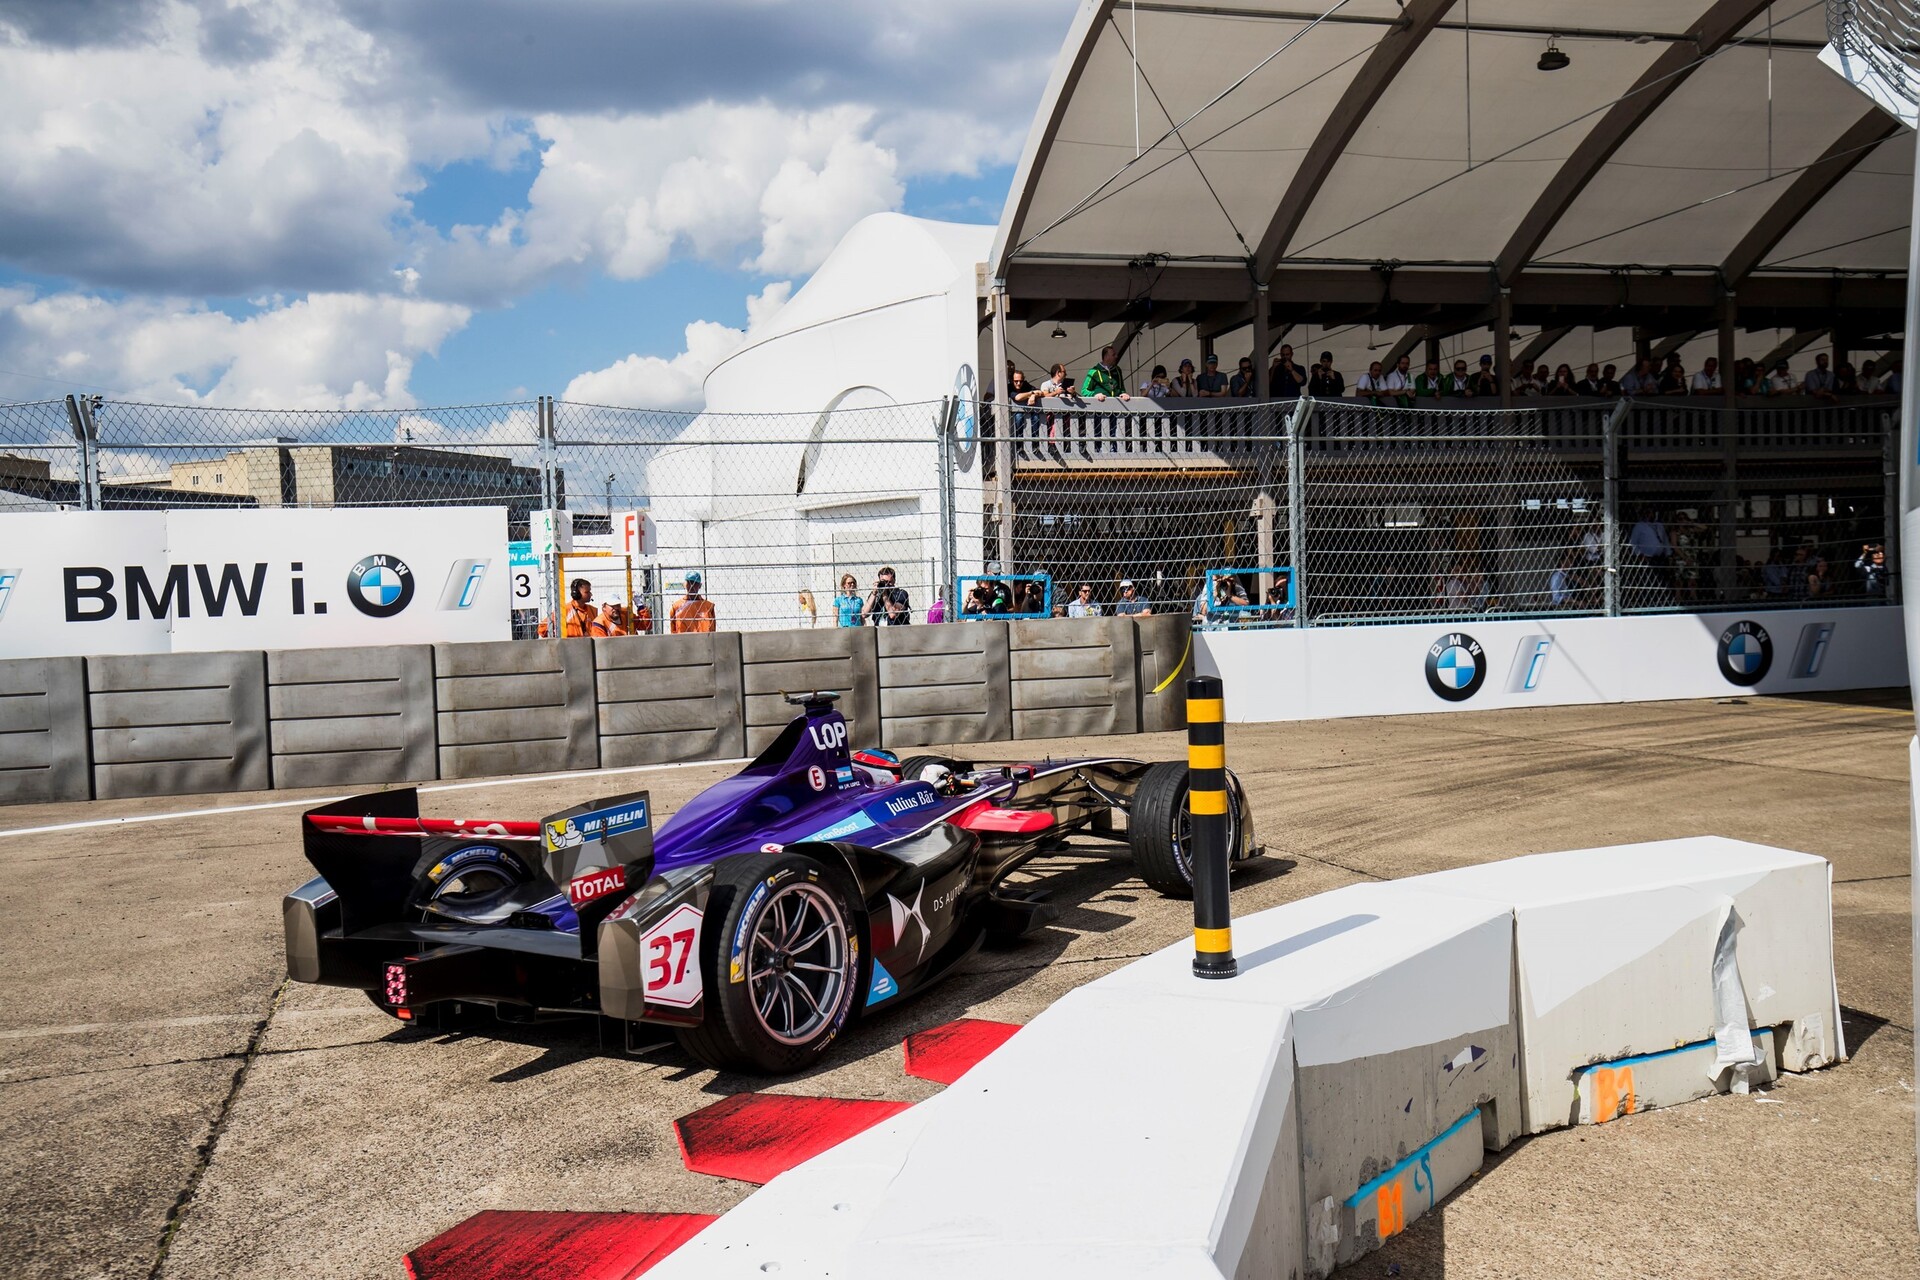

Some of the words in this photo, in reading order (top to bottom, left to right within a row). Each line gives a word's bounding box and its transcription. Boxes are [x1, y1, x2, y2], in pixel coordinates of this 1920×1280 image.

[625, 515, 635, 552] F
[352, 555, 409, 577] BMW
[63, 562, 269, 622] BMW
[291, 561, 328, 615] i.
[459, 564, 486, 608] i
[515, 573, 532, 598] 3
[1430, 634, 1482, 658] BMW
[1721, 622, 1769, 645] BMW
[1524, 641, 1550, 689] i
[808, 721, 847, 751] LOP
[811, 769, 822, 788] E
[885, 796, 919, 816] Julius
[916, 790, 934, 806] Bär
[583, 808, 644, 833] MIHELIN
[451, 848, 498, 864] MICHELIN
[571, 874, 625, 900] TOTAL
[736, 884, 767, 949] MICHELIN
[933, 895, 944, 912] DS
[647, 927, 696, 991] 37
